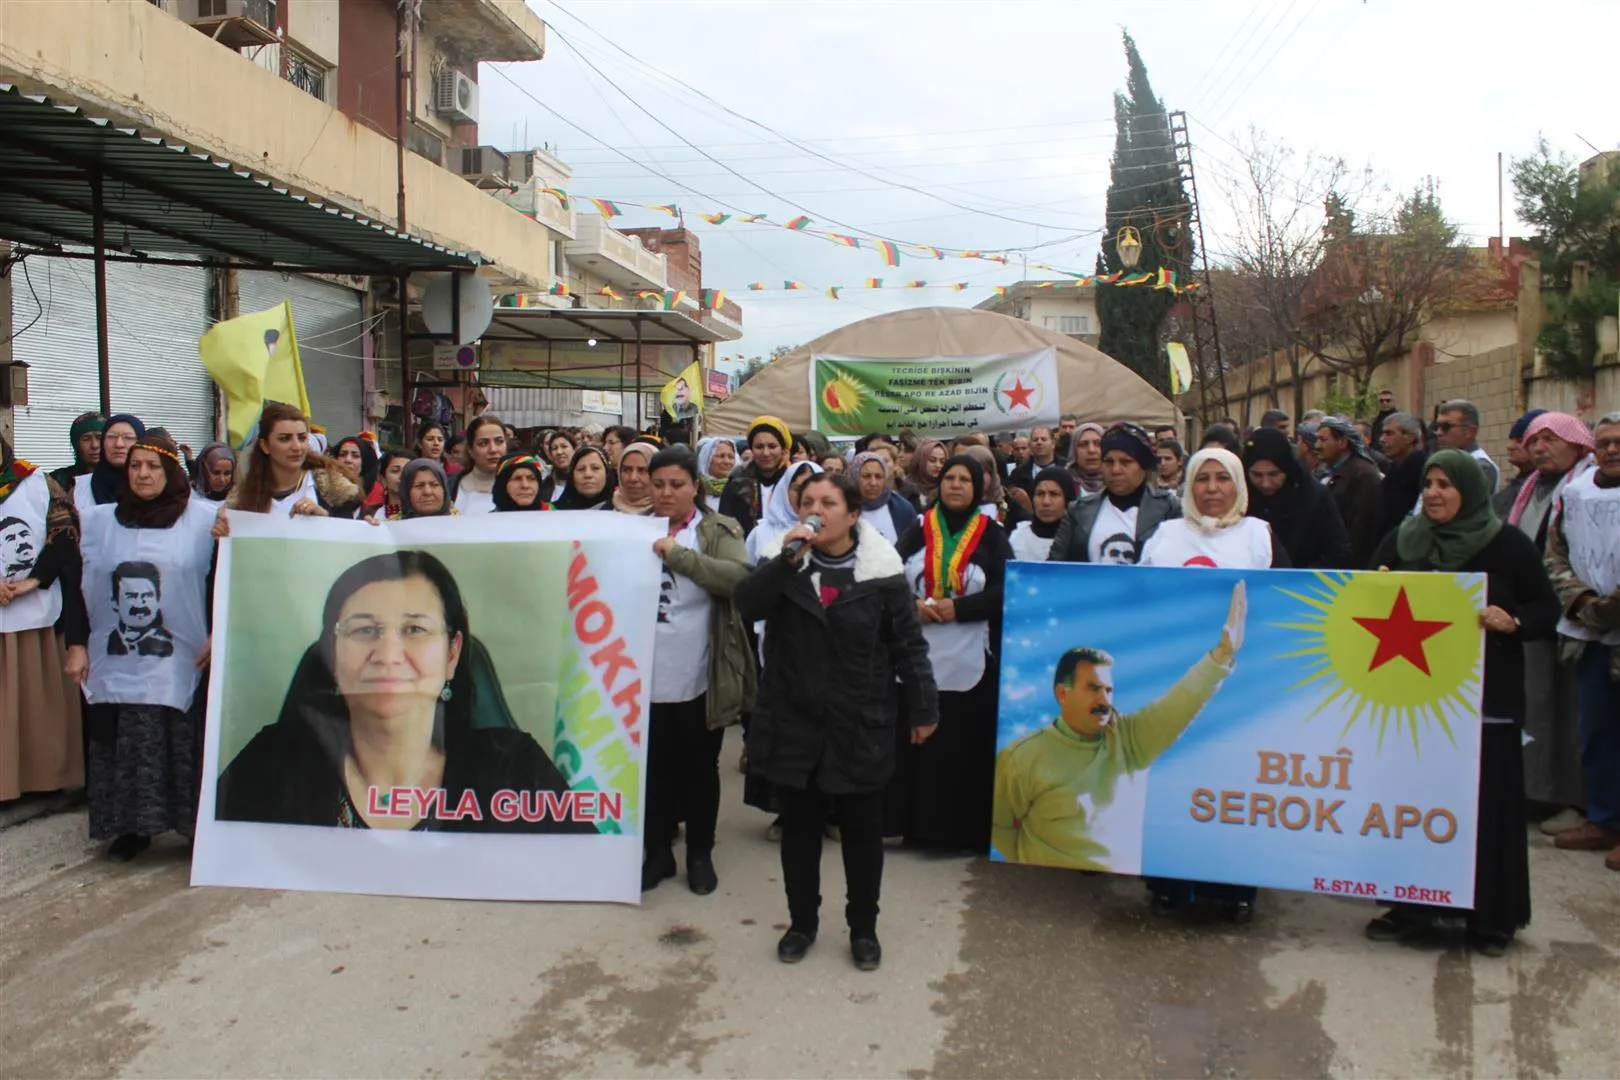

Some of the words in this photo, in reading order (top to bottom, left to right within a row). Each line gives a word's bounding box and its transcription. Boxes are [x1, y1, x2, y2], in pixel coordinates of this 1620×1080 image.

[939, 389, 962, 397] AZAD
[1255, 746, 1353, 790] BIJÎ
[368, 785, 483, 820] LEYLA
[490, 788, 624, 822] GUVEN
[1189, 787, 1346, 834] SEROK
[1359, 802, 1458, 844] APO
[1313, 876, 1377, 896] K.STAR
[1394, 884, 1453, 903] DÊRIK
